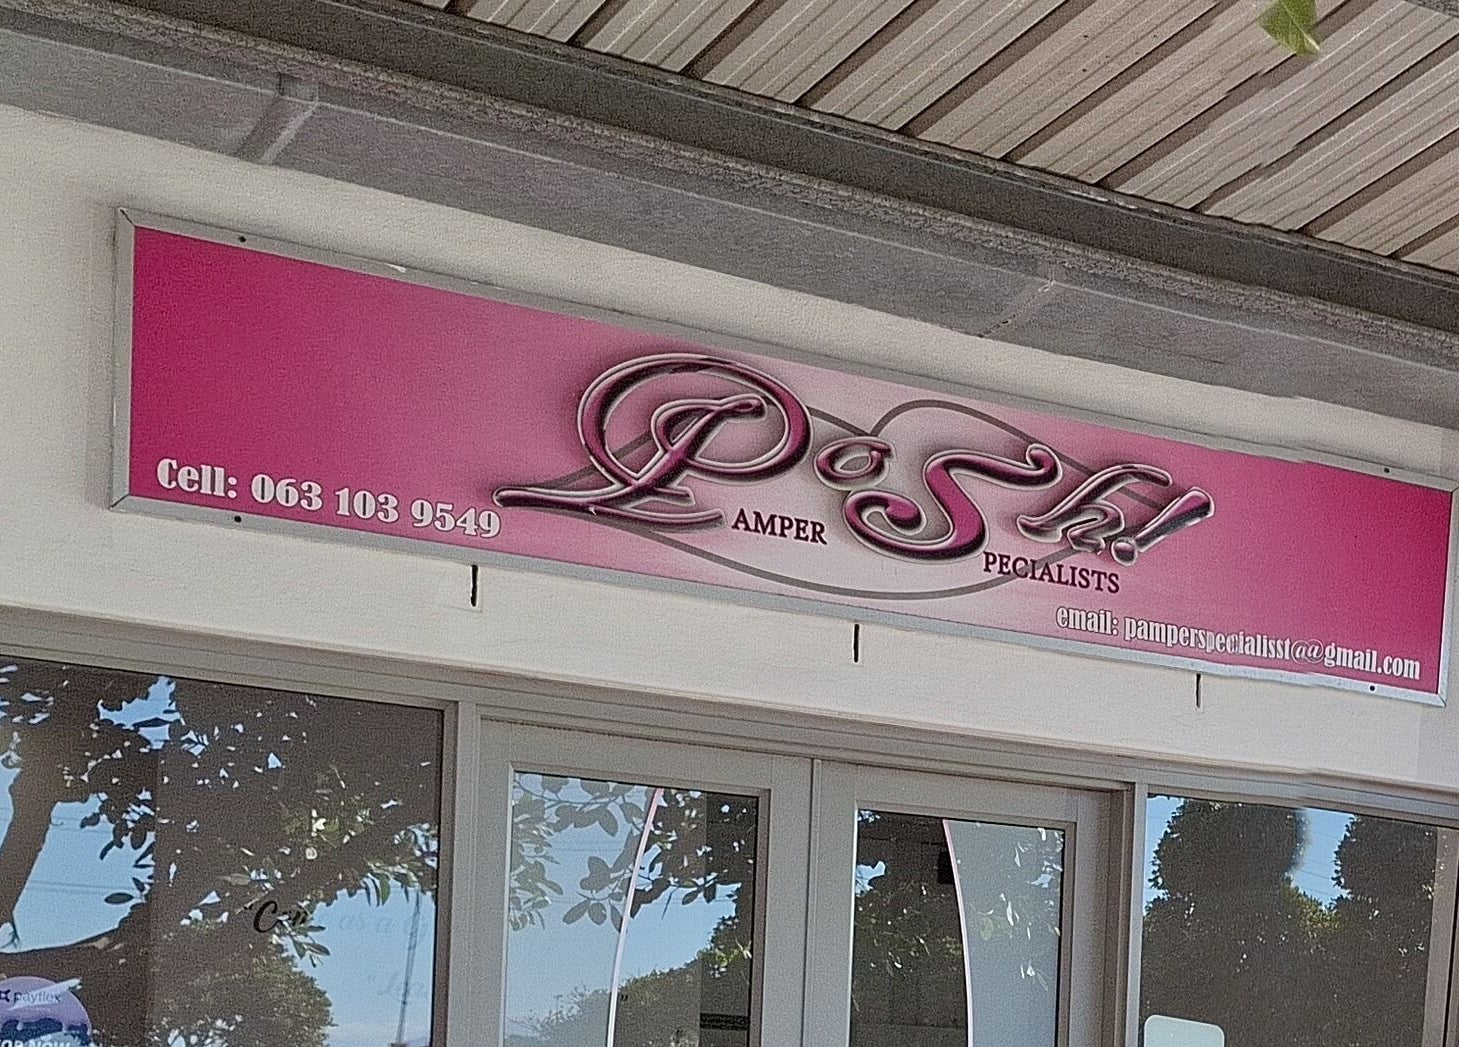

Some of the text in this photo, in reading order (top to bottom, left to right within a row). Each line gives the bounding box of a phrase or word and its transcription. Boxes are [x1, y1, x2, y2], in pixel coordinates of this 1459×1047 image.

[156, 458, 501, 538] Cell: 063 103 9549
[731, 508, 1121, 594] AMPER PECIALISTS
[1056, 606, 1118, 636] email:
